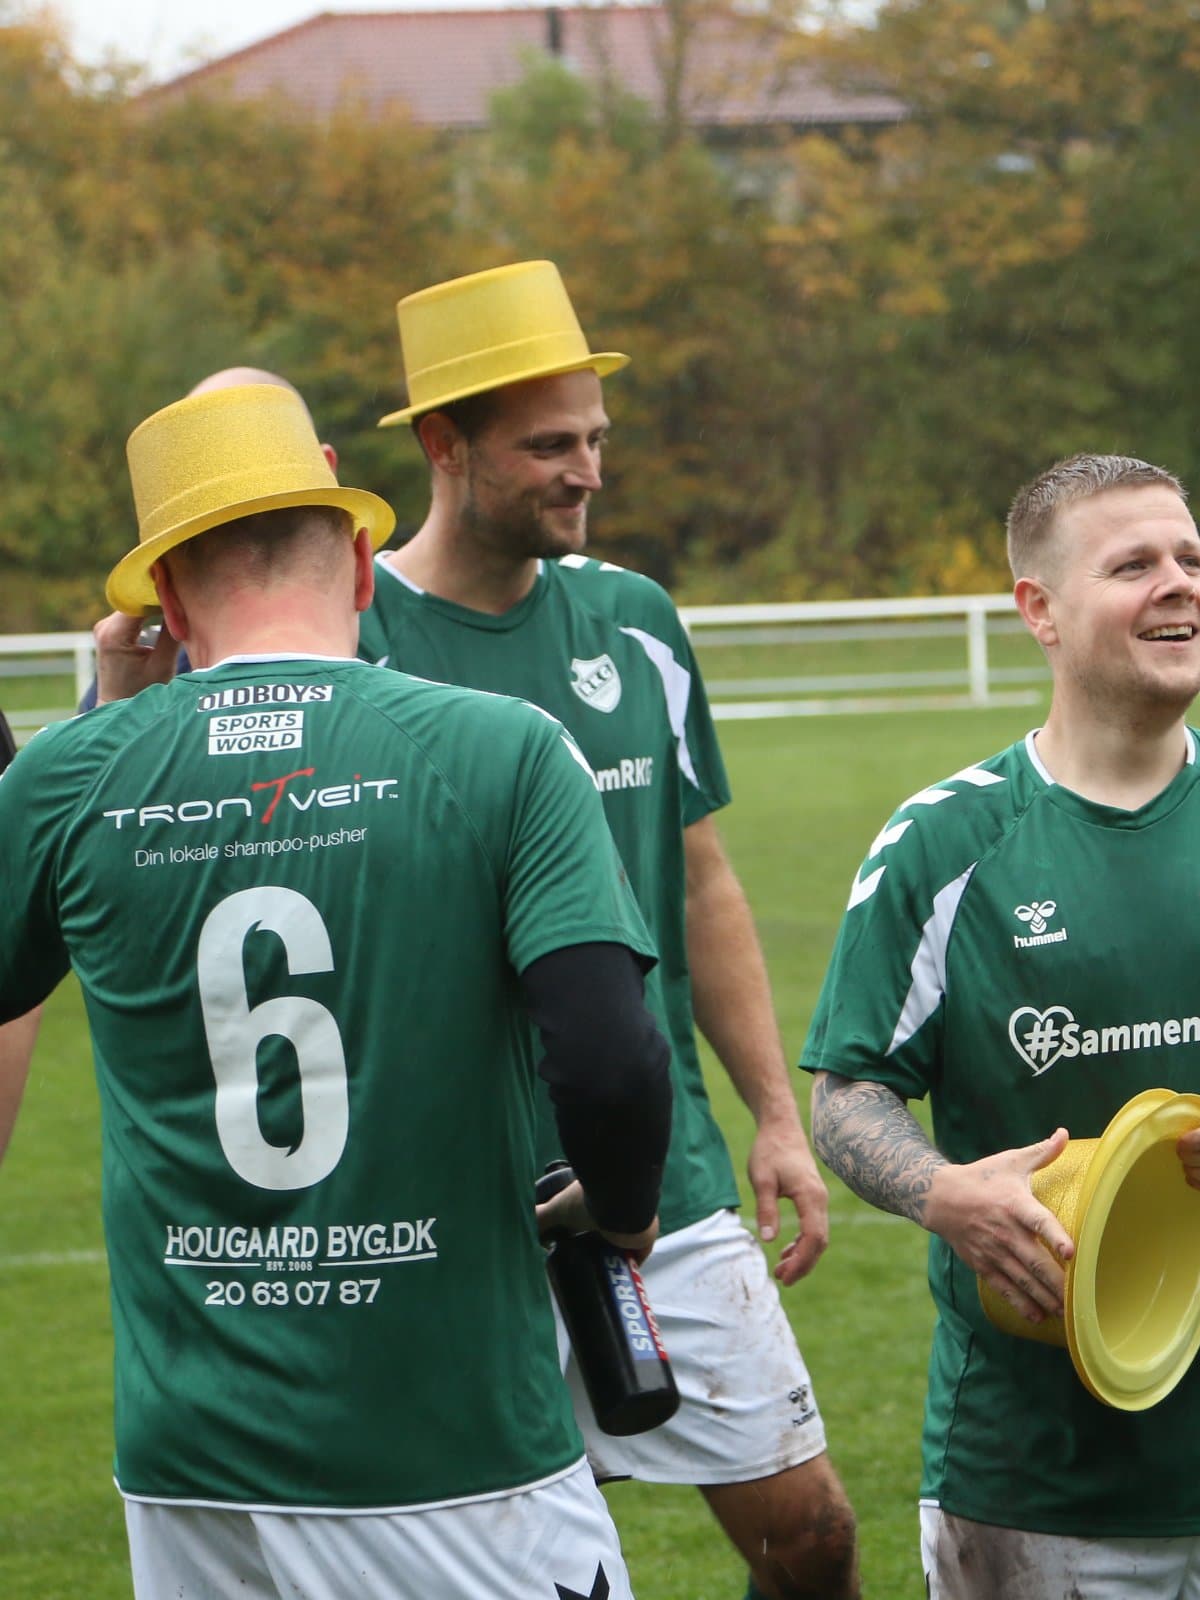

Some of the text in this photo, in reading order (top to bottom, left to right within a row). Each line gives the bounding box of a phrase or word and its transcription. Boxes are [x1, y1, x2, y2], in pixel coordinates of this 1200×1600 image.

[199, 684, 327, 711] OLDBOYS
[216, 713, 297, 732] SPORTS
[217, 733, 296, 752] WORLD
[135, 827, 368, 867] Din lokale shampoo-pusher
[1014, 928, 1068, 948] hummel
[197, 886, 349, 1190] 6
[165, 1218, 438, 1258] HOUGAARD BYG.DK
[204, 1278, 381, 1305] 20 63 07 87
[604, 1256, 655, 1352] SPORTS
